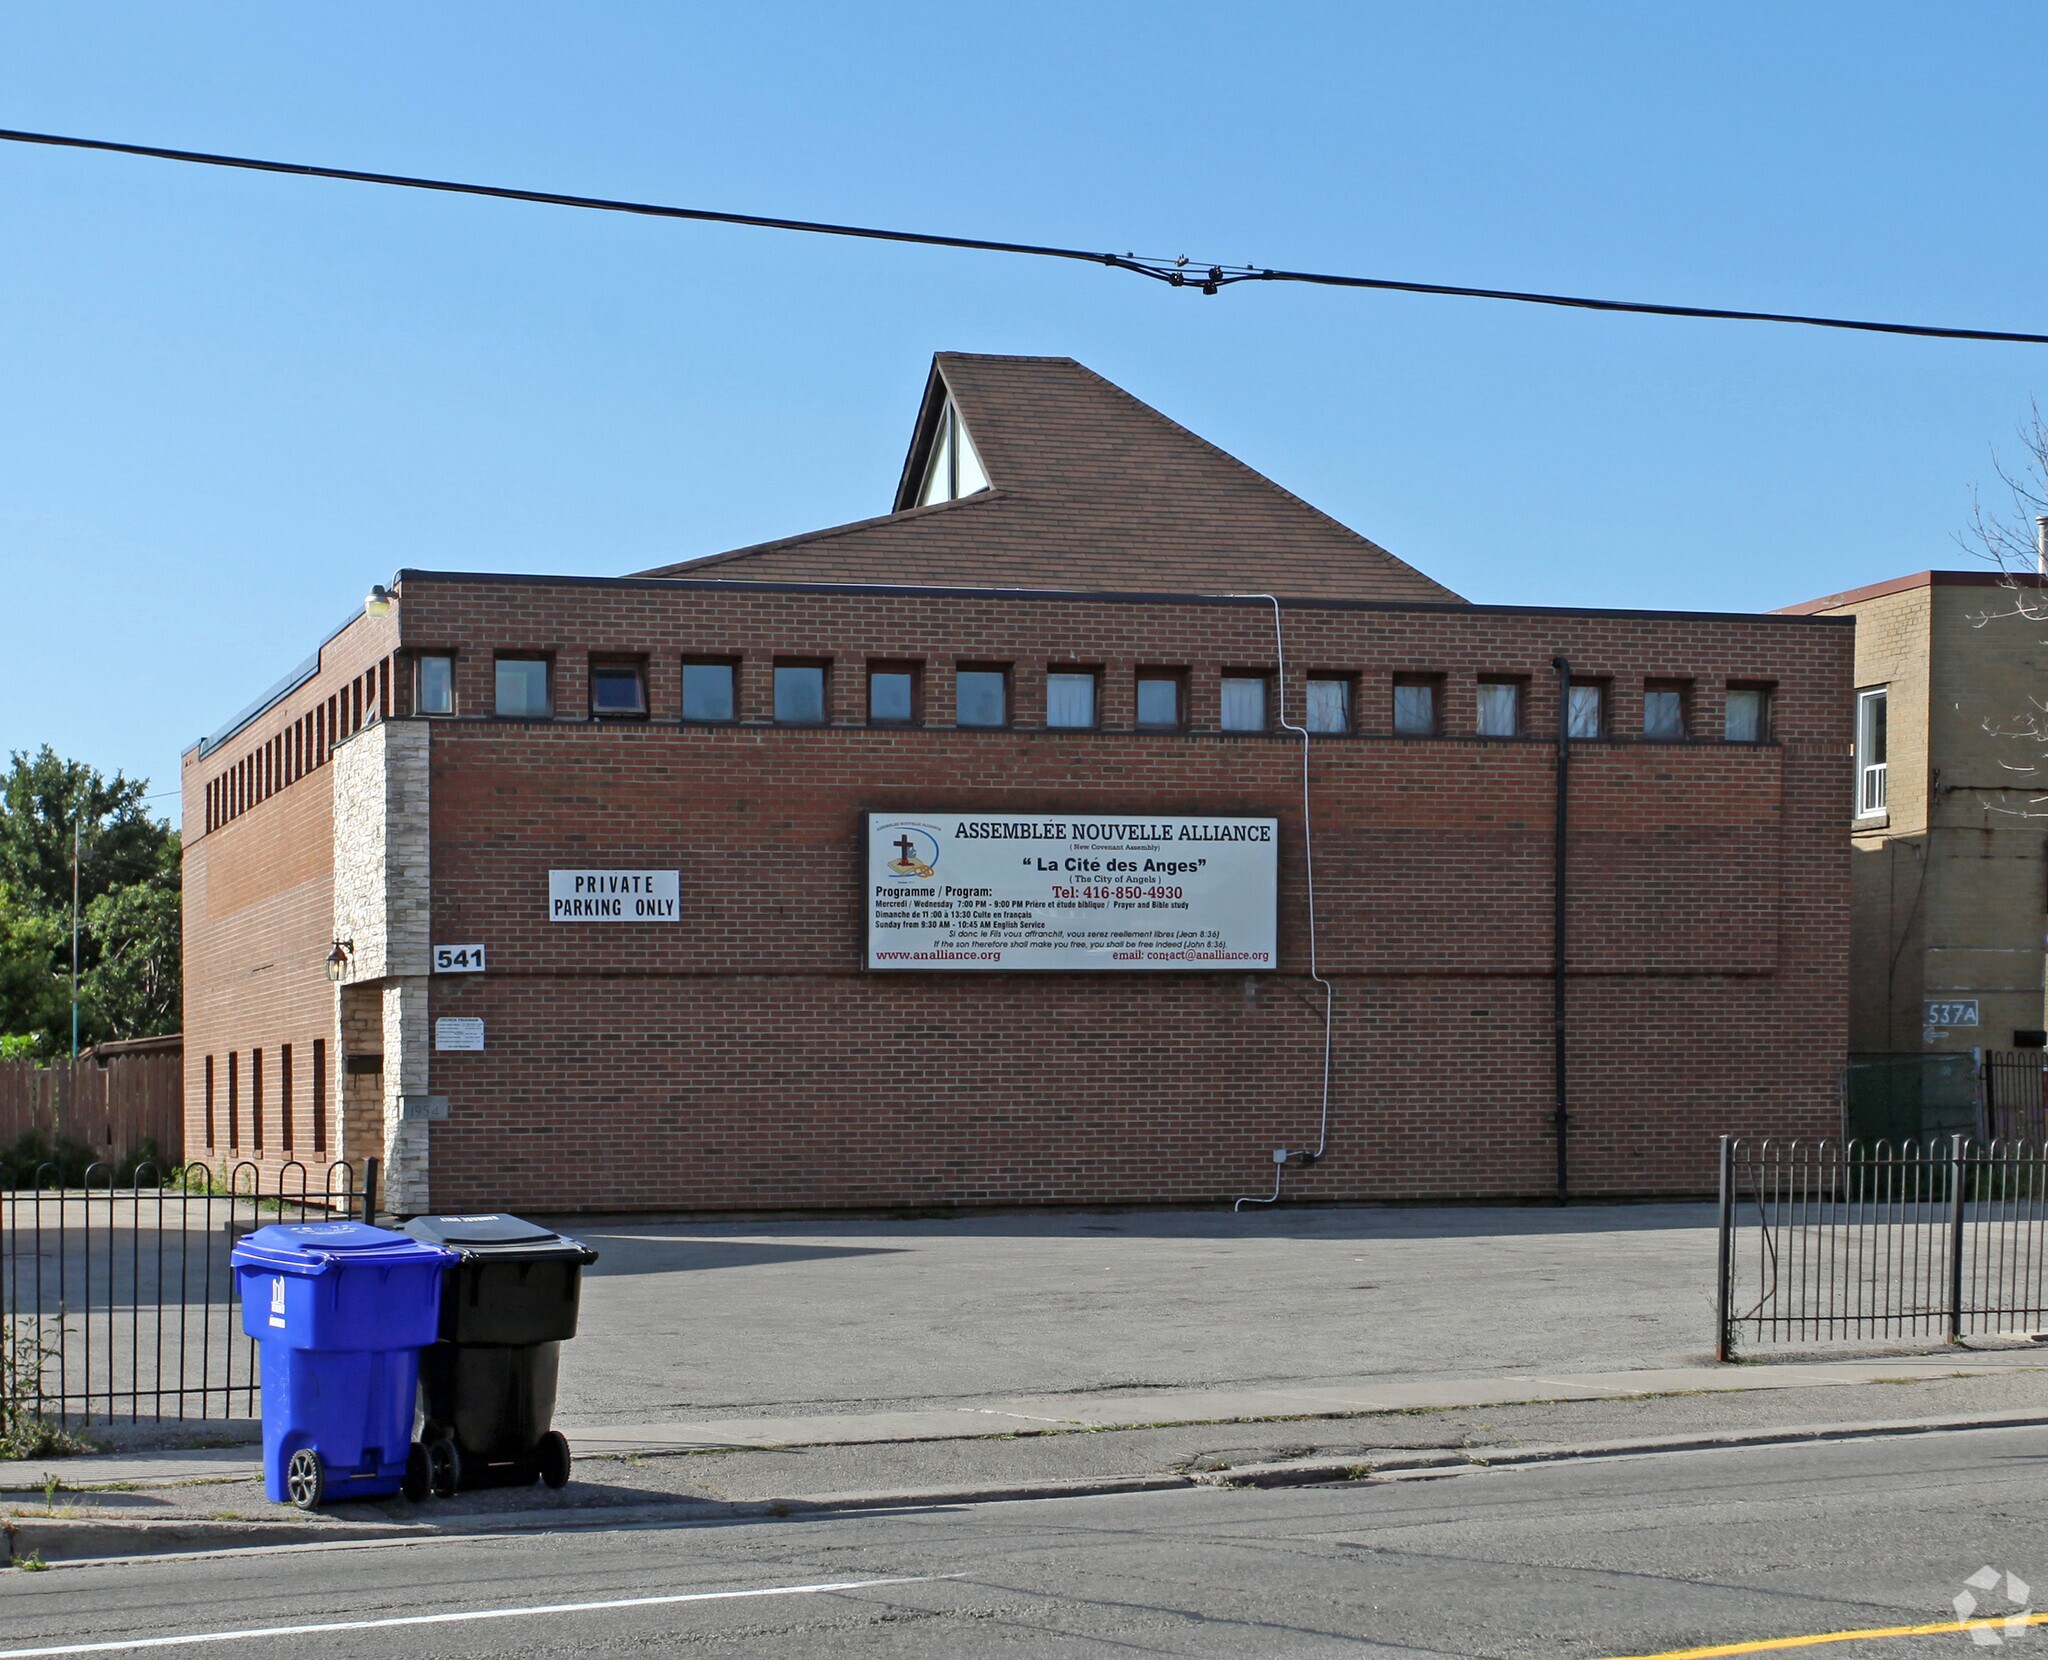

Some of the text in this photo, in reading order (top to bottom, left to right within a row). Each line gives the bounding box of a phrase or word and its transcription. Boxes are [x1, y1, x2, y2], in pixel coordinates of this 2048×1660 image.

[955, 819, 1270, 841] ASSEMBLÉE NOUVELLE ALLIANCE
[1037, 858, 1058, 871] La
[1064, 857, 1100, 872] Cité
[1106, 858, 1137, 872] des
[575, 876, 653, 893] PRIVATE
[1075, 875, 1091, 883] The
[1094, 875, 1112, 884] City
[1114, 875, 1123, 883] of
[1126, 876, 1156, 884] Angels
[876, 886, 935, 898] Programme
[945, 886, 992, 899] Program:
[1052, 886, 1183, 899] Tel: 416-850-4930
[554, 899, 674, 916] PARKING ONLY
[914, 900, 953, 909] Wednesday
[958, 900, 973, 908] 7:00
[976, 900, 986, 908] PM
[994, 900, 1010, 908] 9:00
[1057, 900, 1076, 908] étude
[1078, 901, 1105, 909] biblique
[1114, 901, 1135, 910] Prayer
[1171, 901, 1189, 910] study
[1004, 911, 1032, 920] français
[875, 921, 901, 929] Sunday
[993, 921, 1018, 930] English
[1024, 930, 1064, 938] affranchit,
[1176, 931, 1197, 939] (Jean
[1200, 931, 1220, 939] 8:36)
[1070, 941, 1088, 949] free,
[1183, 941, 1205, 949] (John
[437, 949, 482, 968] 541
[876, 949, 1269, 962] www.analliance.org email: contact@analliance.org
[1929, 1004, 1976, 1024] 537A
[410, 1106, 440, 1118] 1954
